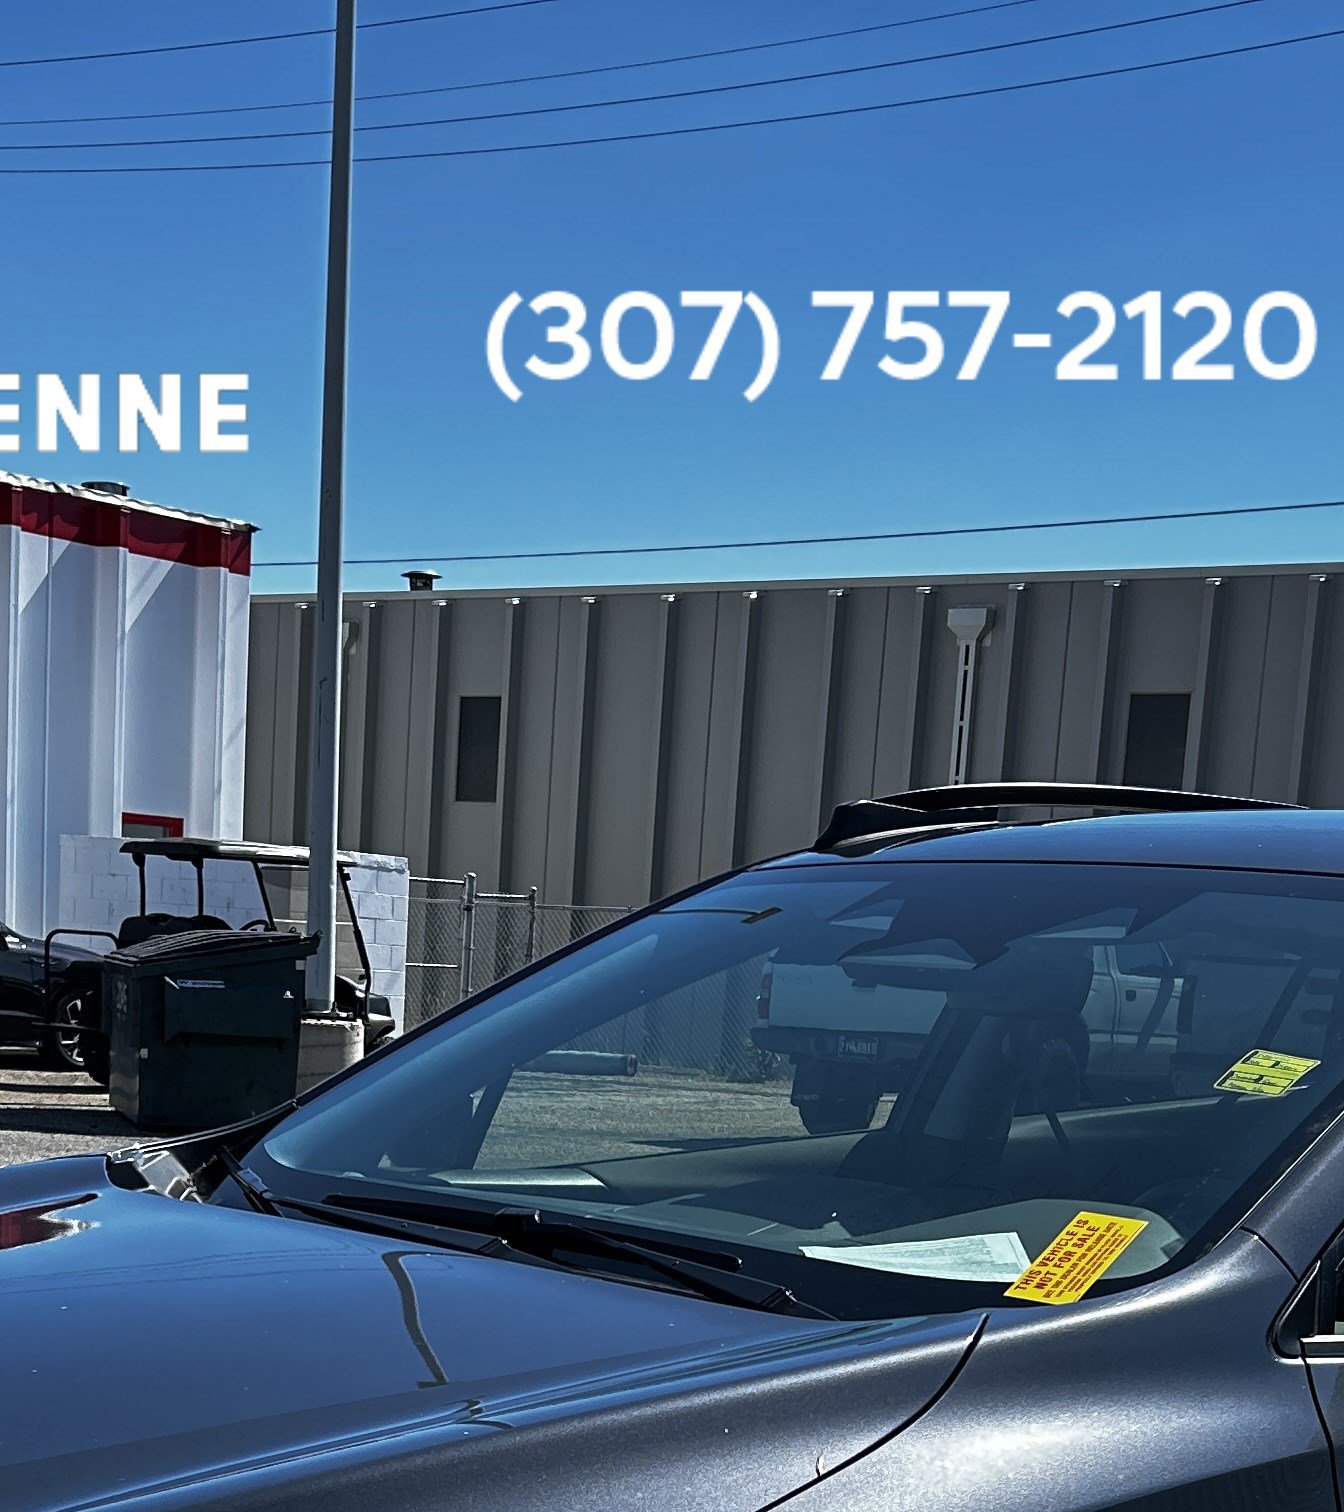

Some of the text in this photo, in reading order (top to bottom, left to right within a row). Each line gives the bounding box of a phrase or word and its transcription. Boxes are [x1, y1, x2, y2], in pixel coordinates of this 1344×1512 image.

[1014, 1269, 1042, 1291] THIS
[1038, 1229, 1078, 1268] VEHICLE
[1073, 1218, 1090, 1229] IS
[1033, 1270, 1055, 1290] NOT
[1053, 1250, 1077, 1269] FOR
[1071, 1225, 1101, 1249] SALE
